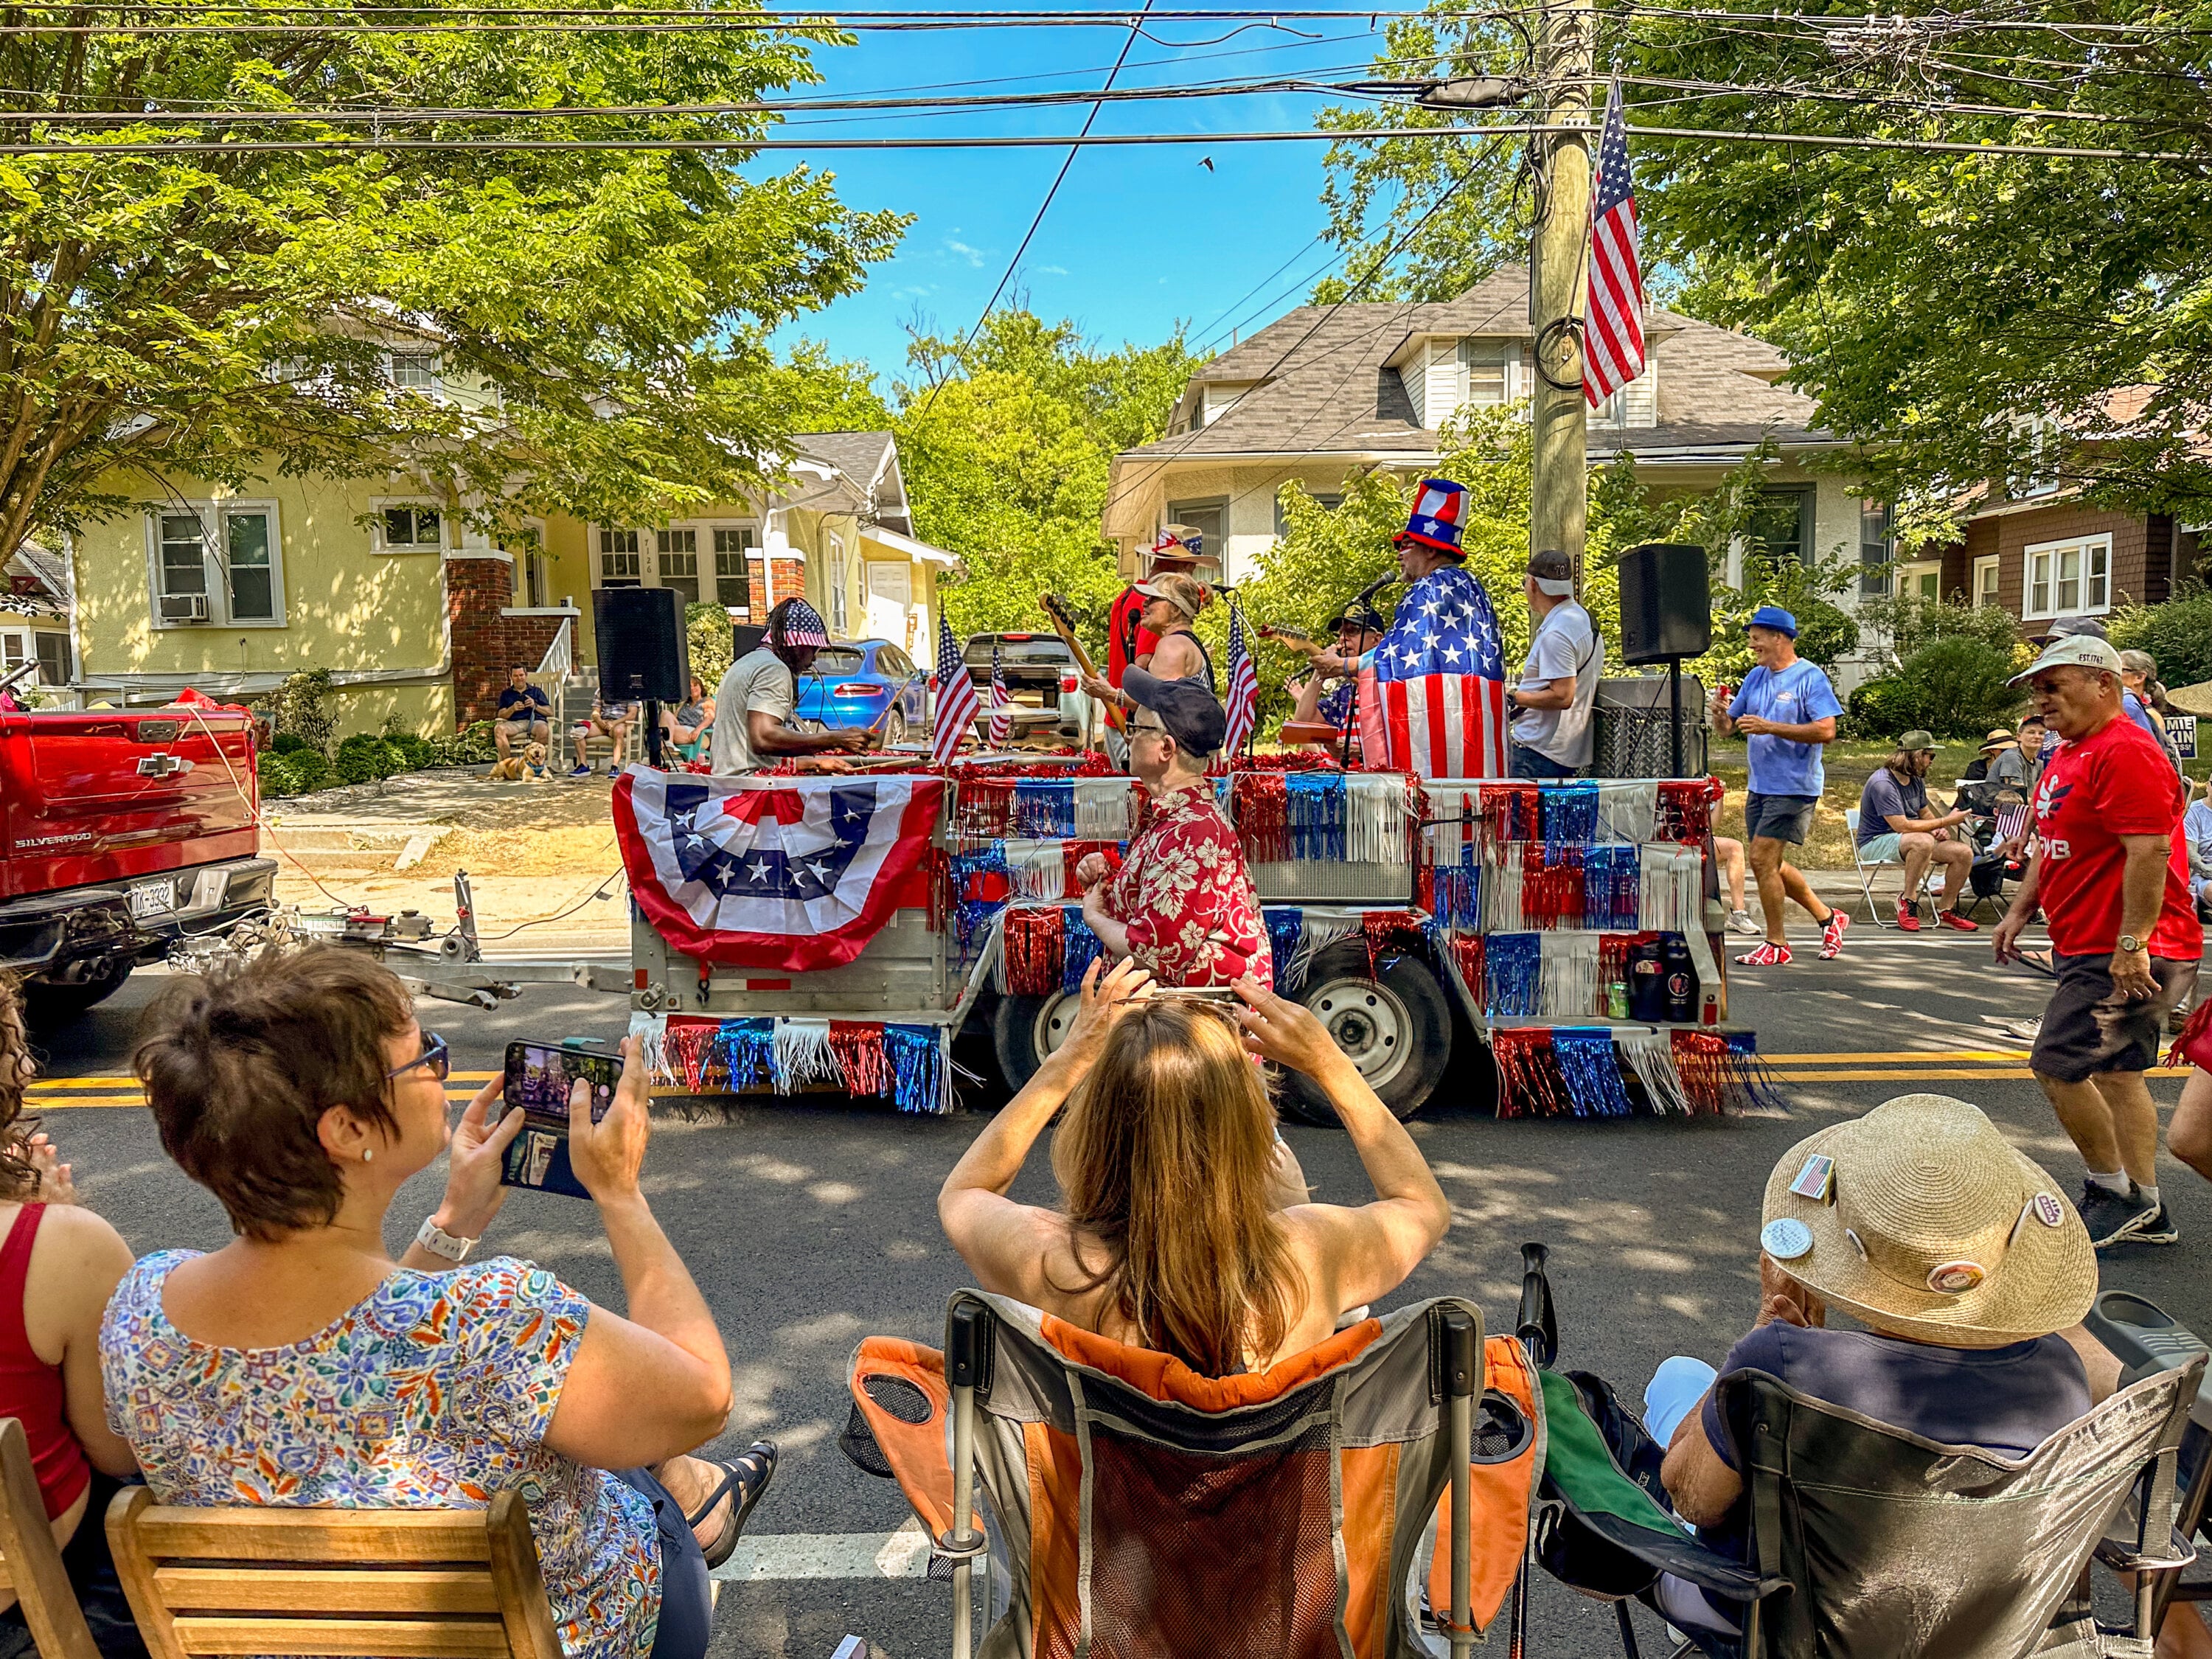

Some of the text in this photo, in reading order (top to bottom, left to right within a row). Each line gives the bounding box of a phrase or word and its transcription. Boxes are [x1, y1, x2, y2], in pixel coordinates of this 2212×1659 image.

[2166, 719, 2193, 730] MIE
[2167, 731, 2194, 743] KIN
[15, 832, 91, 848] SILVERADO
[2040, 1197, 2056, 1222] VOTE
